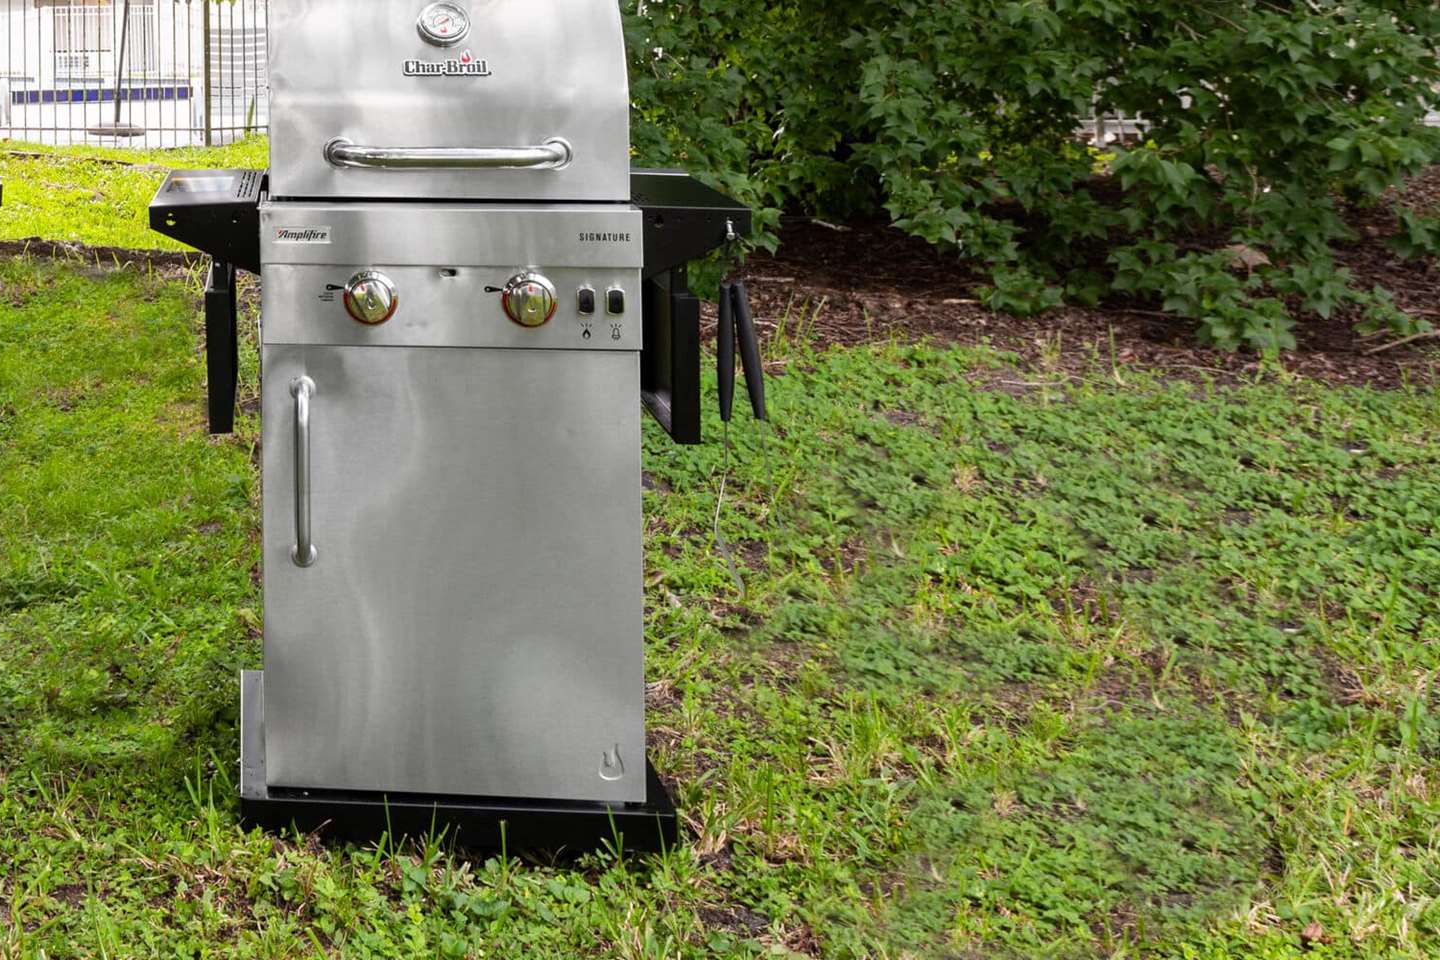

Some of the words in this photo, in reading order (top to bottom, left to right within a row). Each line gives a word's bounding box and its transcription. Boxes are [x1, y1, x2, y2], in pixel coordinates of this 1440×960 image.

[404, 60, 487, 73] Char-Broil
[277, 229, 327, 241] Amplifire
[579, 232, 631, 242] SIGNATURE
